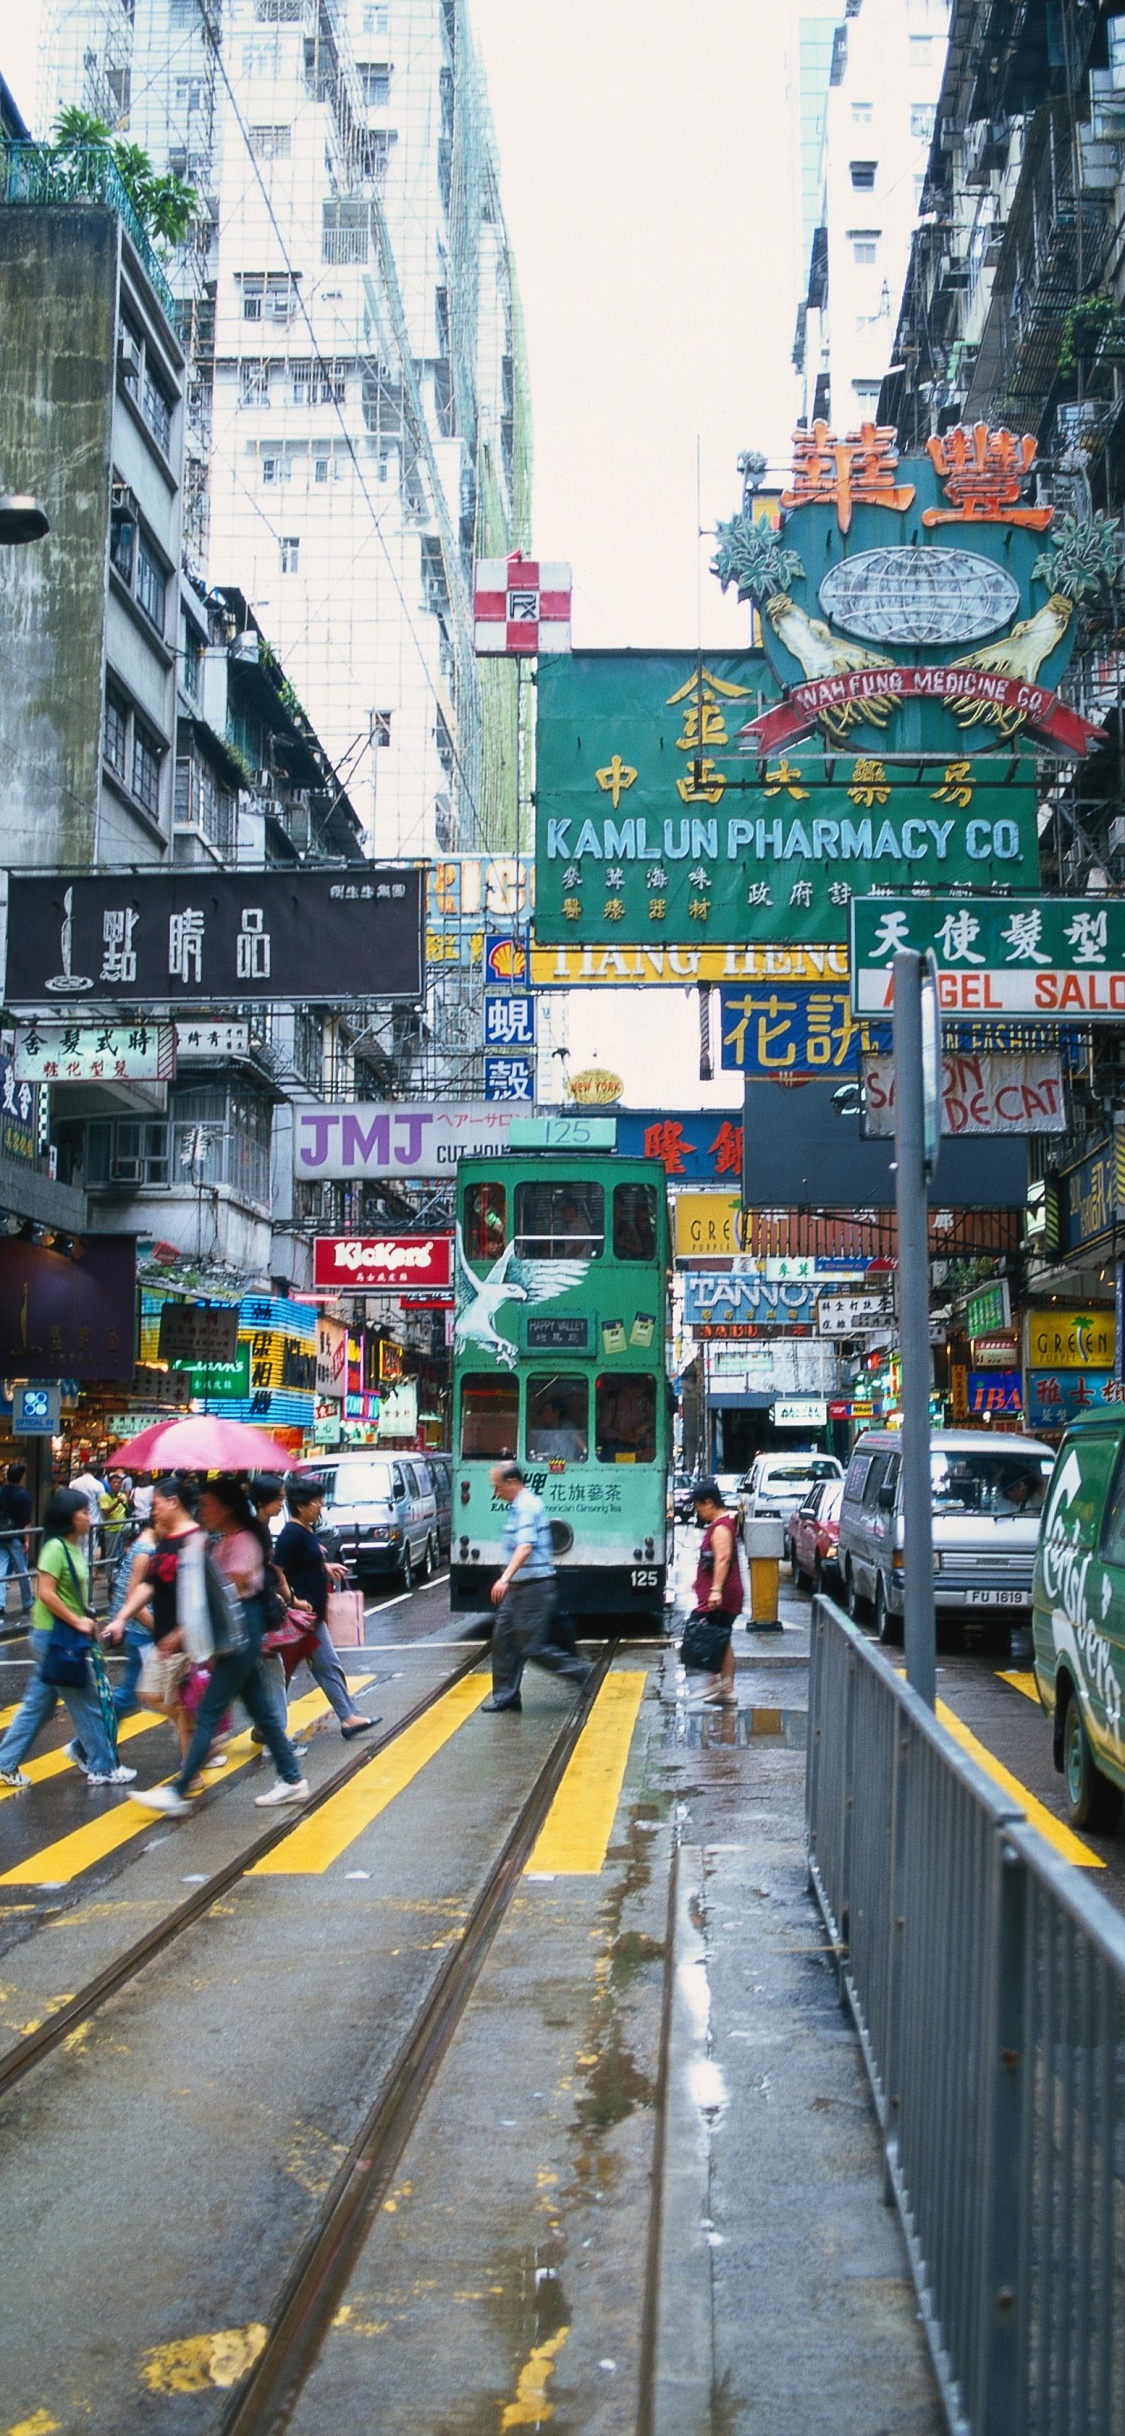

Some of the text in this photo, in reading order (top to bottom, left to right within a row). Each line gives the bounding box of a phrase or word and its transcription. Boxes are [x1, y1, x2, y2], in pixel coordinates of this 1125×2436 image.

[781, 418, 1056, 534] 華豐
[797, 680, 845, 709] WAH
[850, 672, 903, 698] FUNG
[914, 671, 1009, 701] MEDICINE
[667, 666, 753, 750] 金
[547, 817, 718, 861] KAMLUN
[727, 818, 955, 861] PHARMACY
[868, 908, 1125, 965] 天使髮型
[882, 974, 1003, 1010] GEL
[301, 1113, 433, 1167] JMJ
[545, 1120, 591, 1144] 125
[436, 1144, 467, 1163] CUT
[690, 1218, 731, 1242] GRE
[689, 1277, 826, 1308] TANNOY
[529, 1320, 585, 1331] HAPPY VALLEY
[1037, 1333, 1108, 1354] GREEN
[631, 1570, 658, 1587] 125
[972, 1591, 1022, 1604] FU 1619
